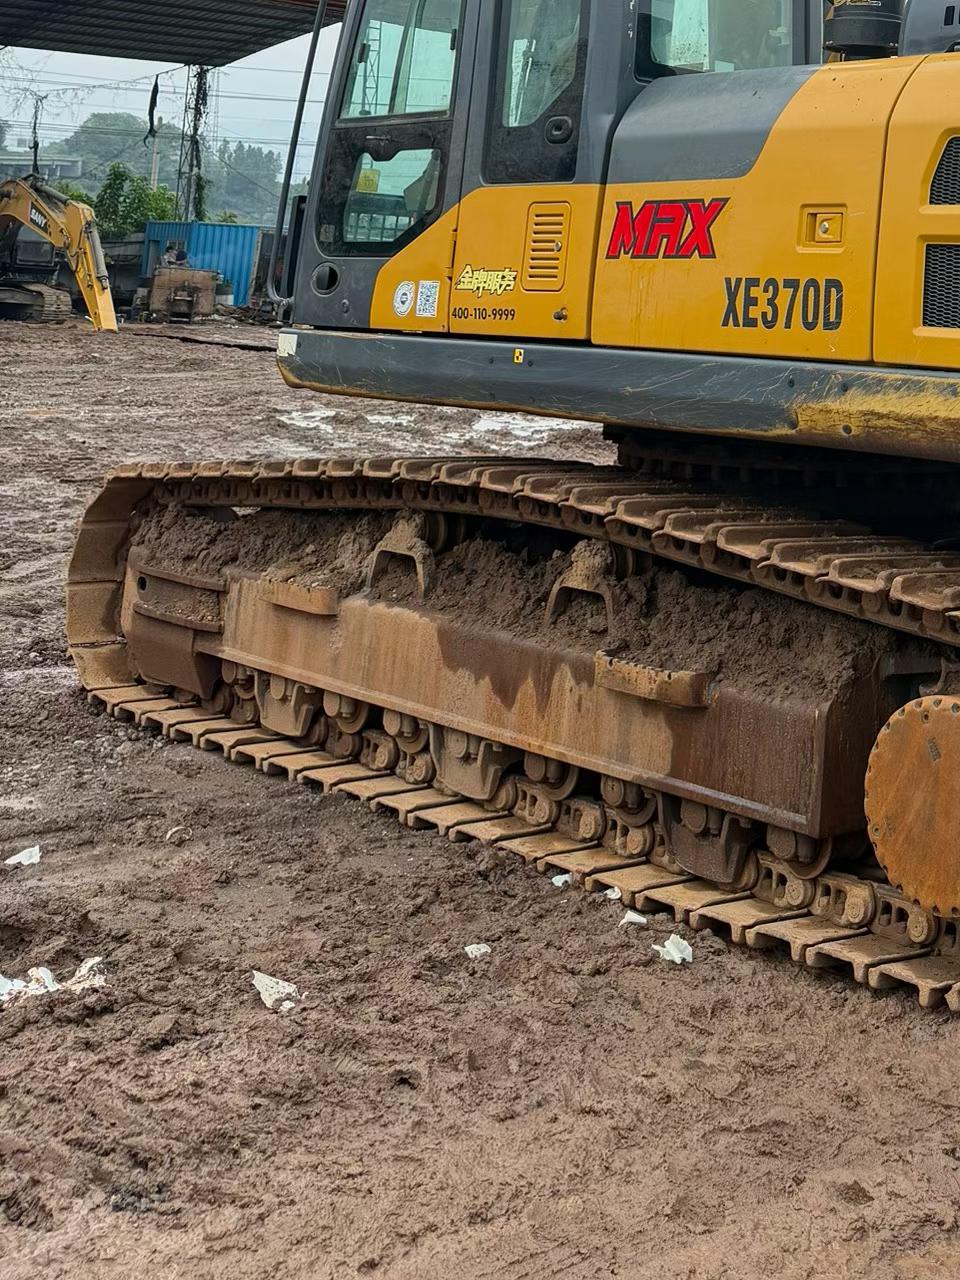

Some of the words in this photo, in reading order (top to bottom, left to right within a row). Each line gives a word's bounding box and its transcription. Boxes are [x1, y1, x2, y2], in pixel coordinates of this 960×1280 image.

[30, 208, 47, 228] SANY
[605, 197, 731, 259] MAX
[455, 264, 518, 298] 金牌服务
[451, 307, 516, 321] 400-110-9999
[721, 277, 843, 331] XE370D
